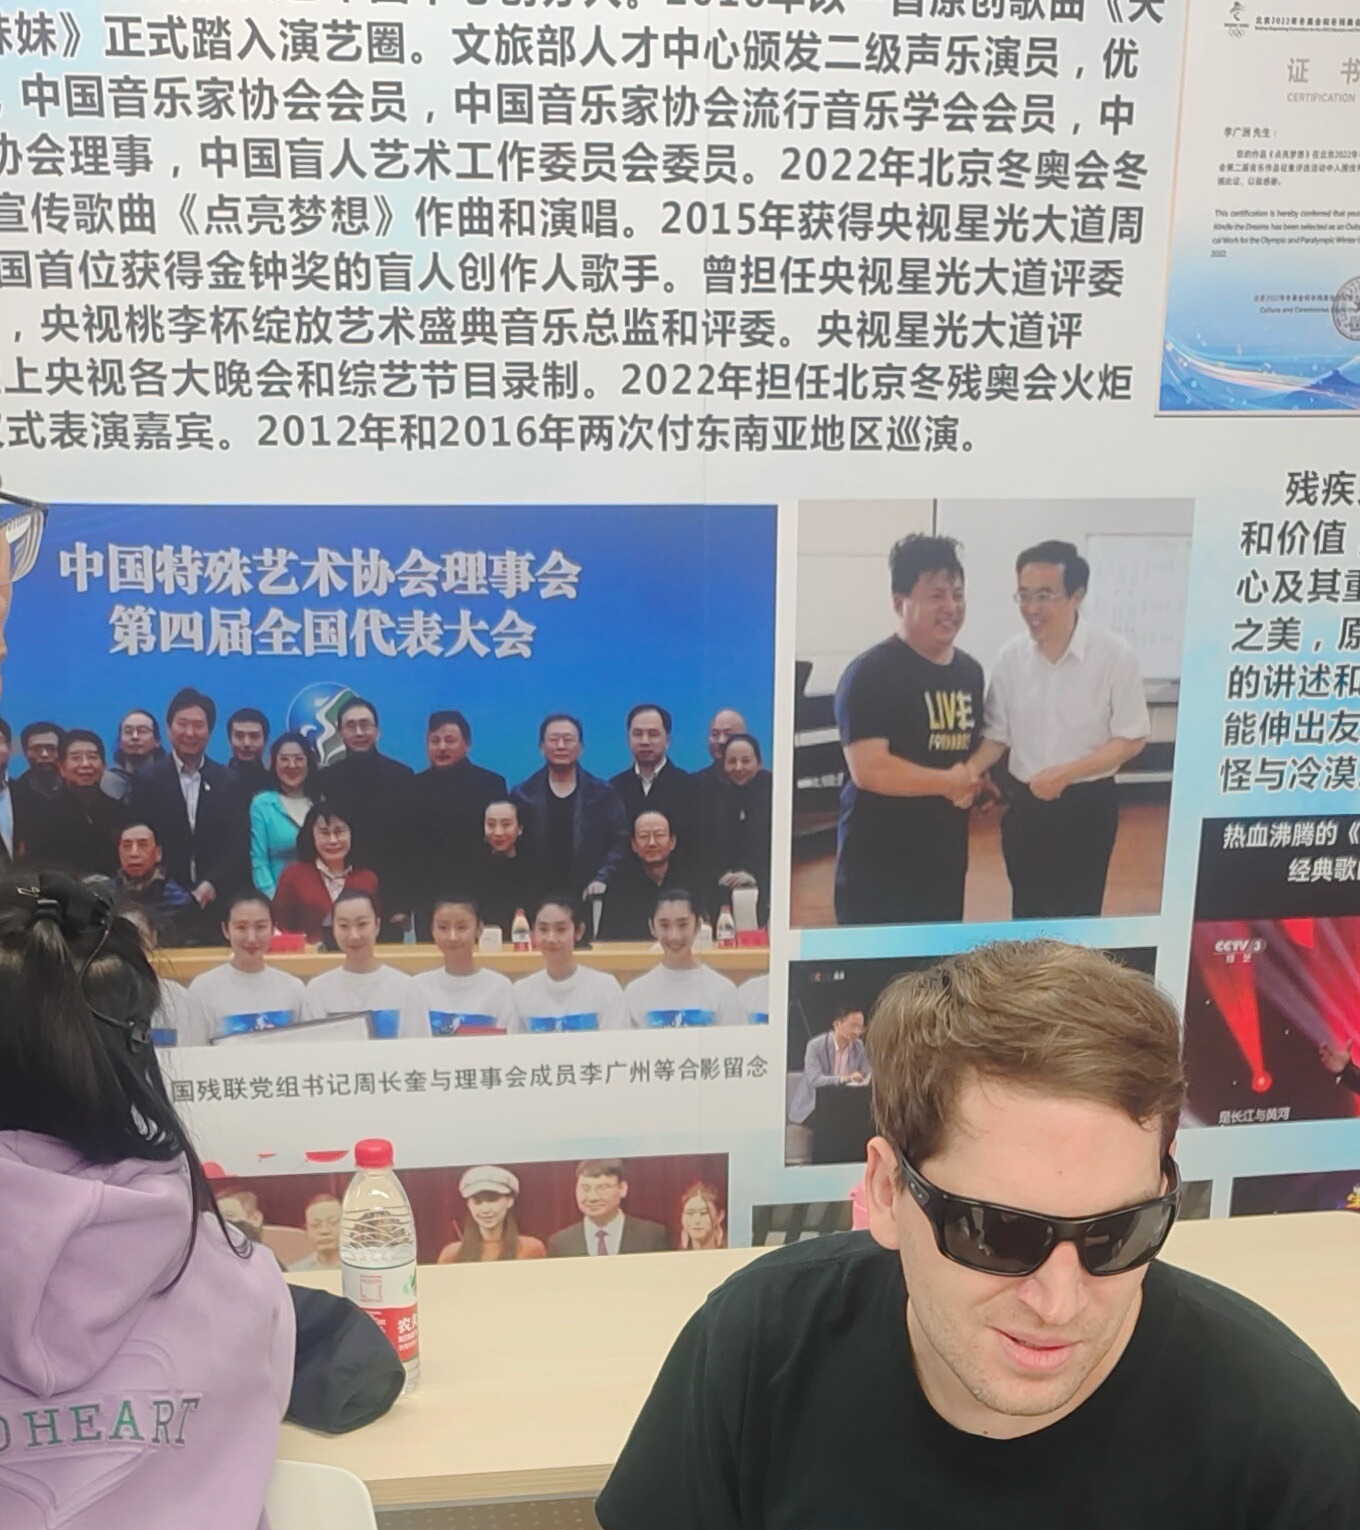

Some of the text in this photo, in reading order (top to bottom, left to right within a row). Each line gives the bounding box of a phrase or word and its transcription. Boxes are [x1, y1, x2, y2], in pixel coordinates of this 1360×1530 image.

[1287, 92, 1356, 103] CERTIFICATION
[58, 542, 583, 601] 中国特殊艺术协会理事会
[108, 604, 537, 661] 第四届全国代表大会
[1215, 940, 1249, 952] CCTV
